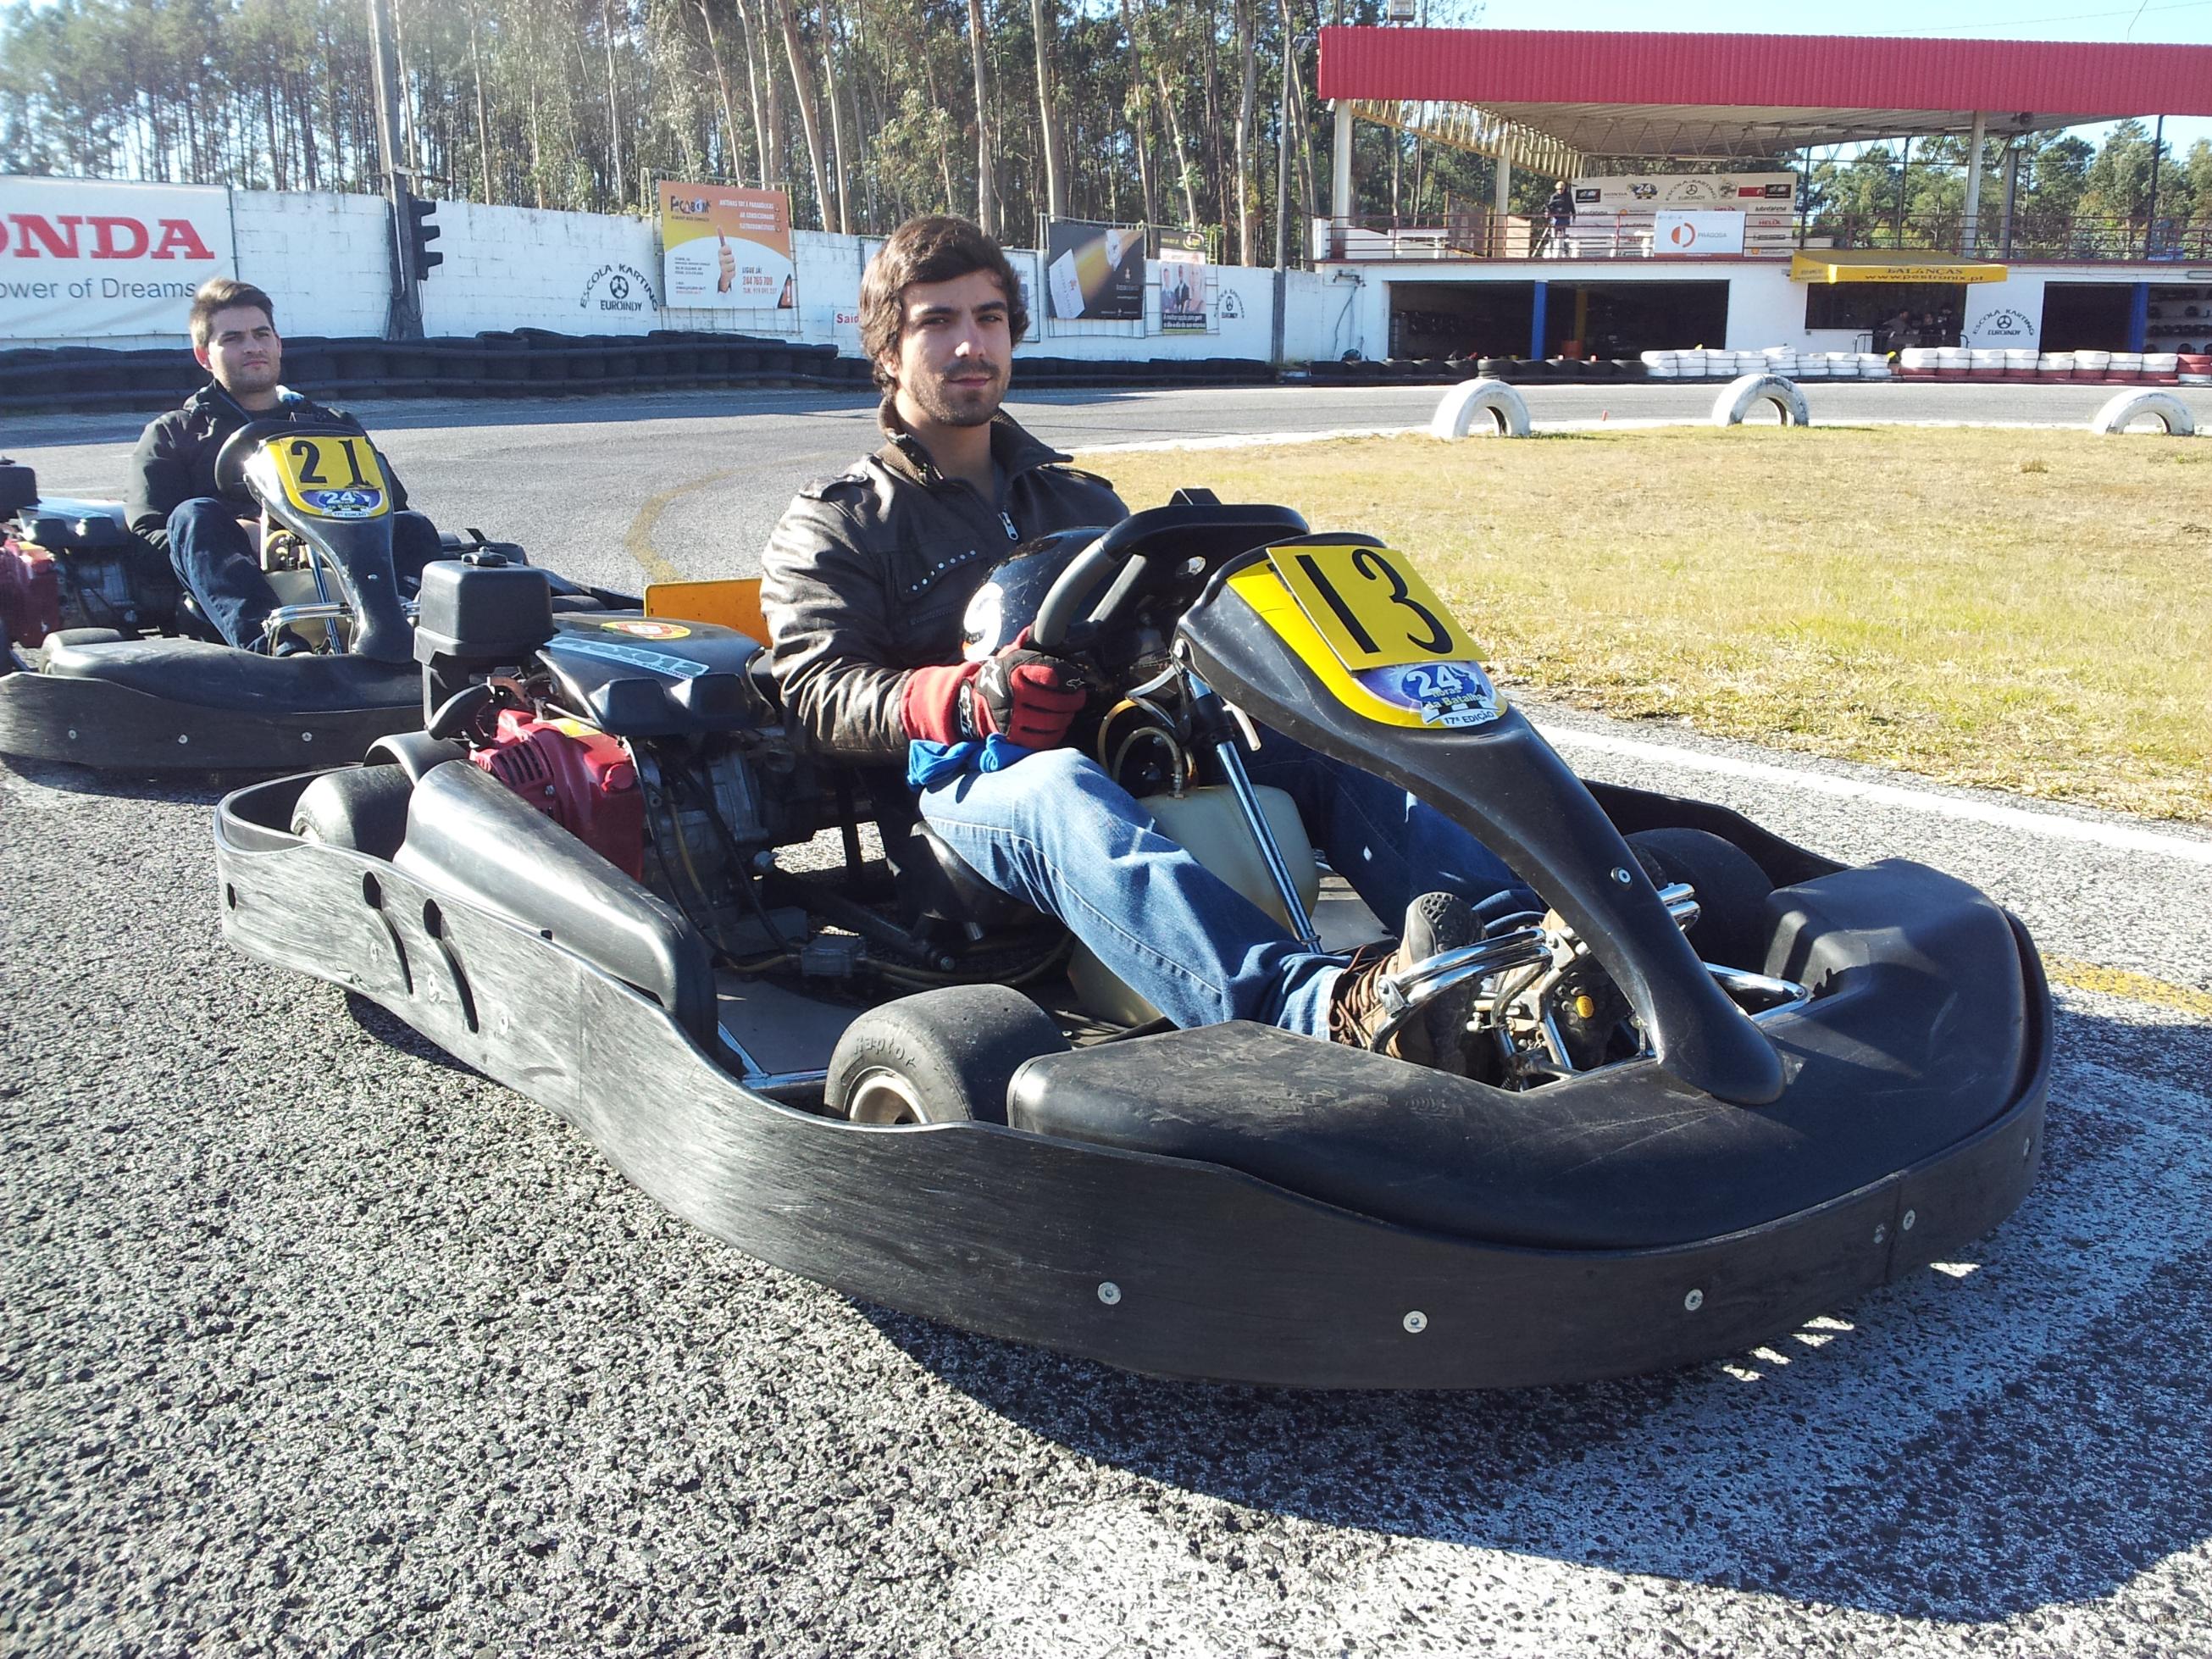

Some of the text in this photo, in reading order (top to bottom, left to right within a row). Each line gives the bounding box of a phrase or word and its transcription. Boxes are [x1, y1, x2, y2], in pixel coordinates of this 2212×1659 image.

[1635, 184, 1652, 193] 24
[0, 214, 215, 259] NDA
[68, 278, 92, 298] of
[103, 278, 196, 298] Dreams
[579, 264, 613, 308] ESCOLA
[618, 264, 658, 312] KARTING
[600, 299, 642, 312] EUROINDY
[1972, 308, 2035, 336] ESCOLA KARTING
[291, 439, 374, 488] 21
[324, 491, 356, 504] 24
[1295, 548, 1454, 654] 13
[1405, 665, 1463, 698] 24
[1442, 693, 1488, 707] Batalha
[1463, 710, 1494, 723] EDIÇÃO
